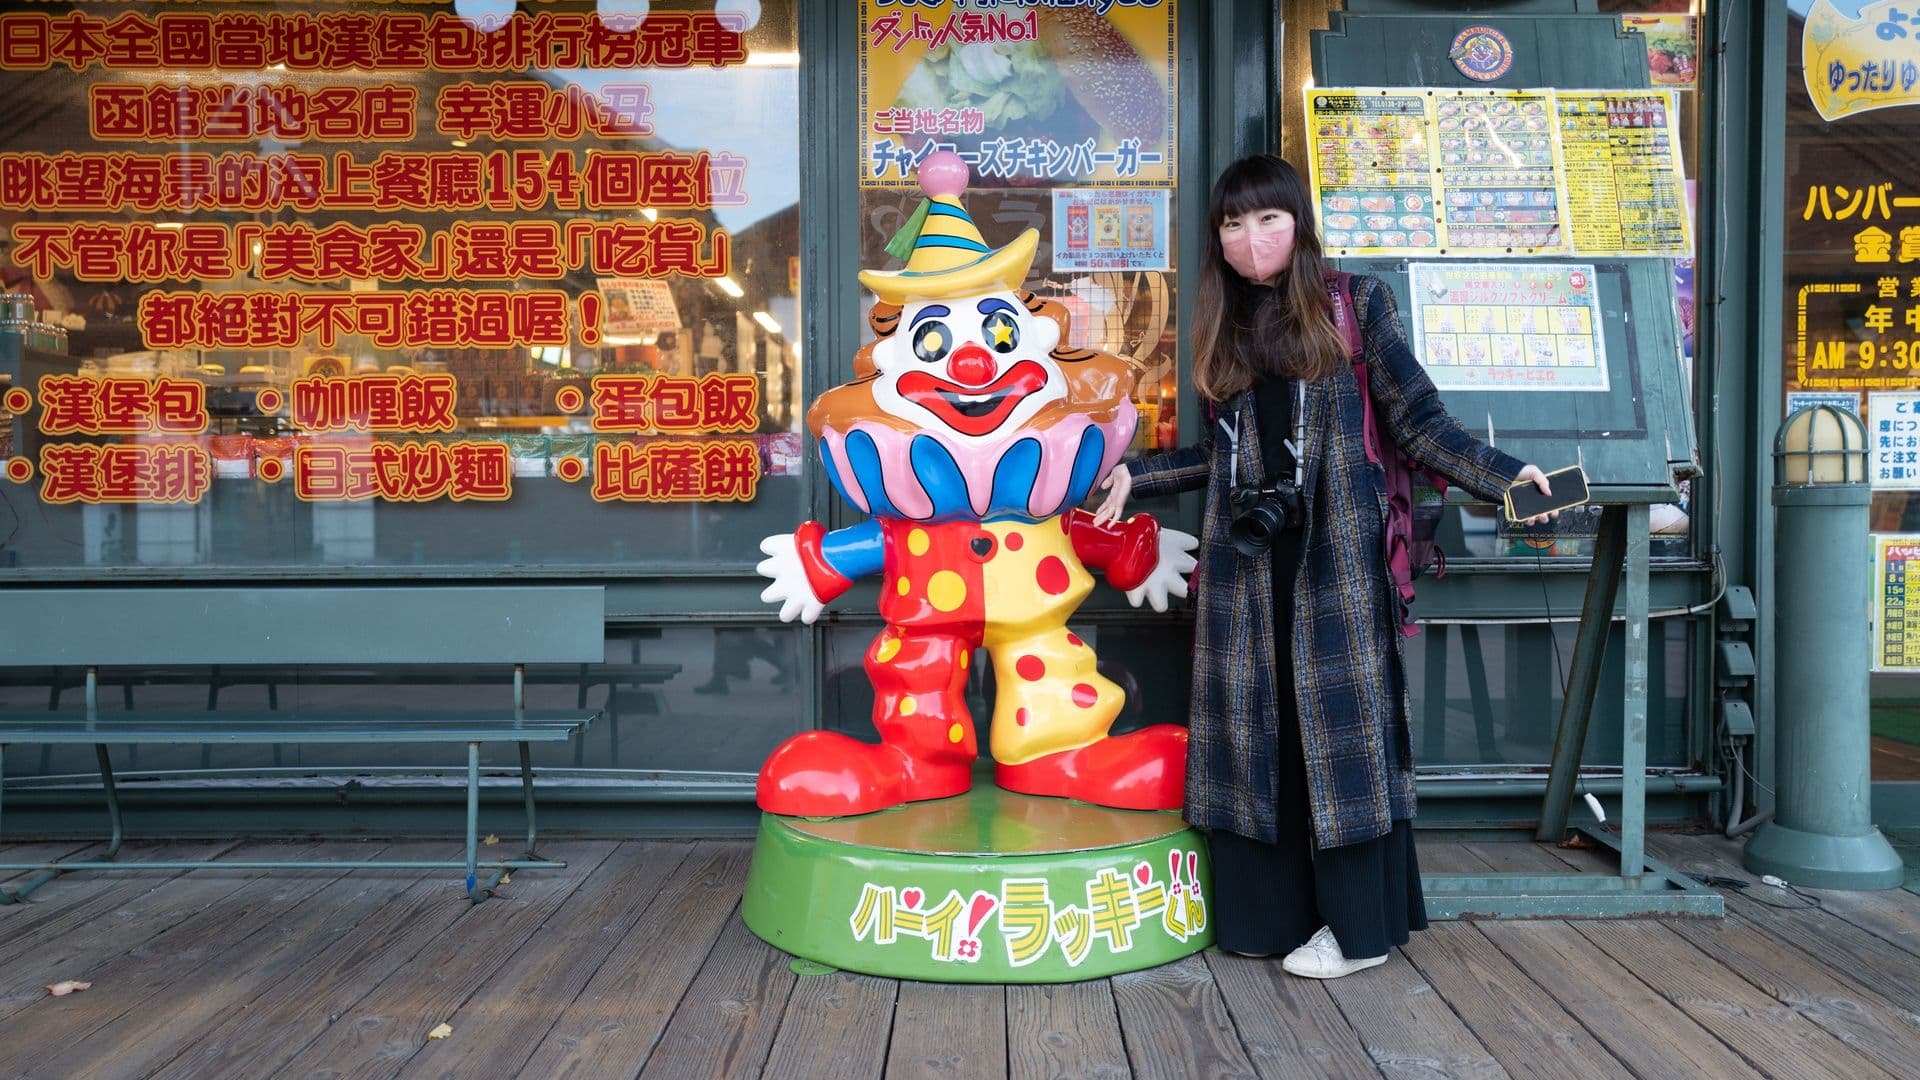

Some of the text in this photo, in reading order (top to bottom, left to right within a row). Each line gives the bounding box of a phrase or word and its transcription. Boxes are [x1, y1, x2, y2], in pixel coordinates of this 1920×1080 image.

[2, 14, 747, 69] 日本全國當地漢堡包排行榜冠軍
[92, 84, 655, 140] 函館当地名店 幸運小丑
[873, 108, 984, 133] ご当地名物
[2, 152, 748, 210] 眺望海景的海上餐廳154個座位
[1812, 341, 1846, 370] AM
[41, 377, 206, 433] 漢堡包
[593, 376, 757, 432] 蛋包飯
[42, 445, 758, 501] 漢堡排 日式炒麵 比薩餅
